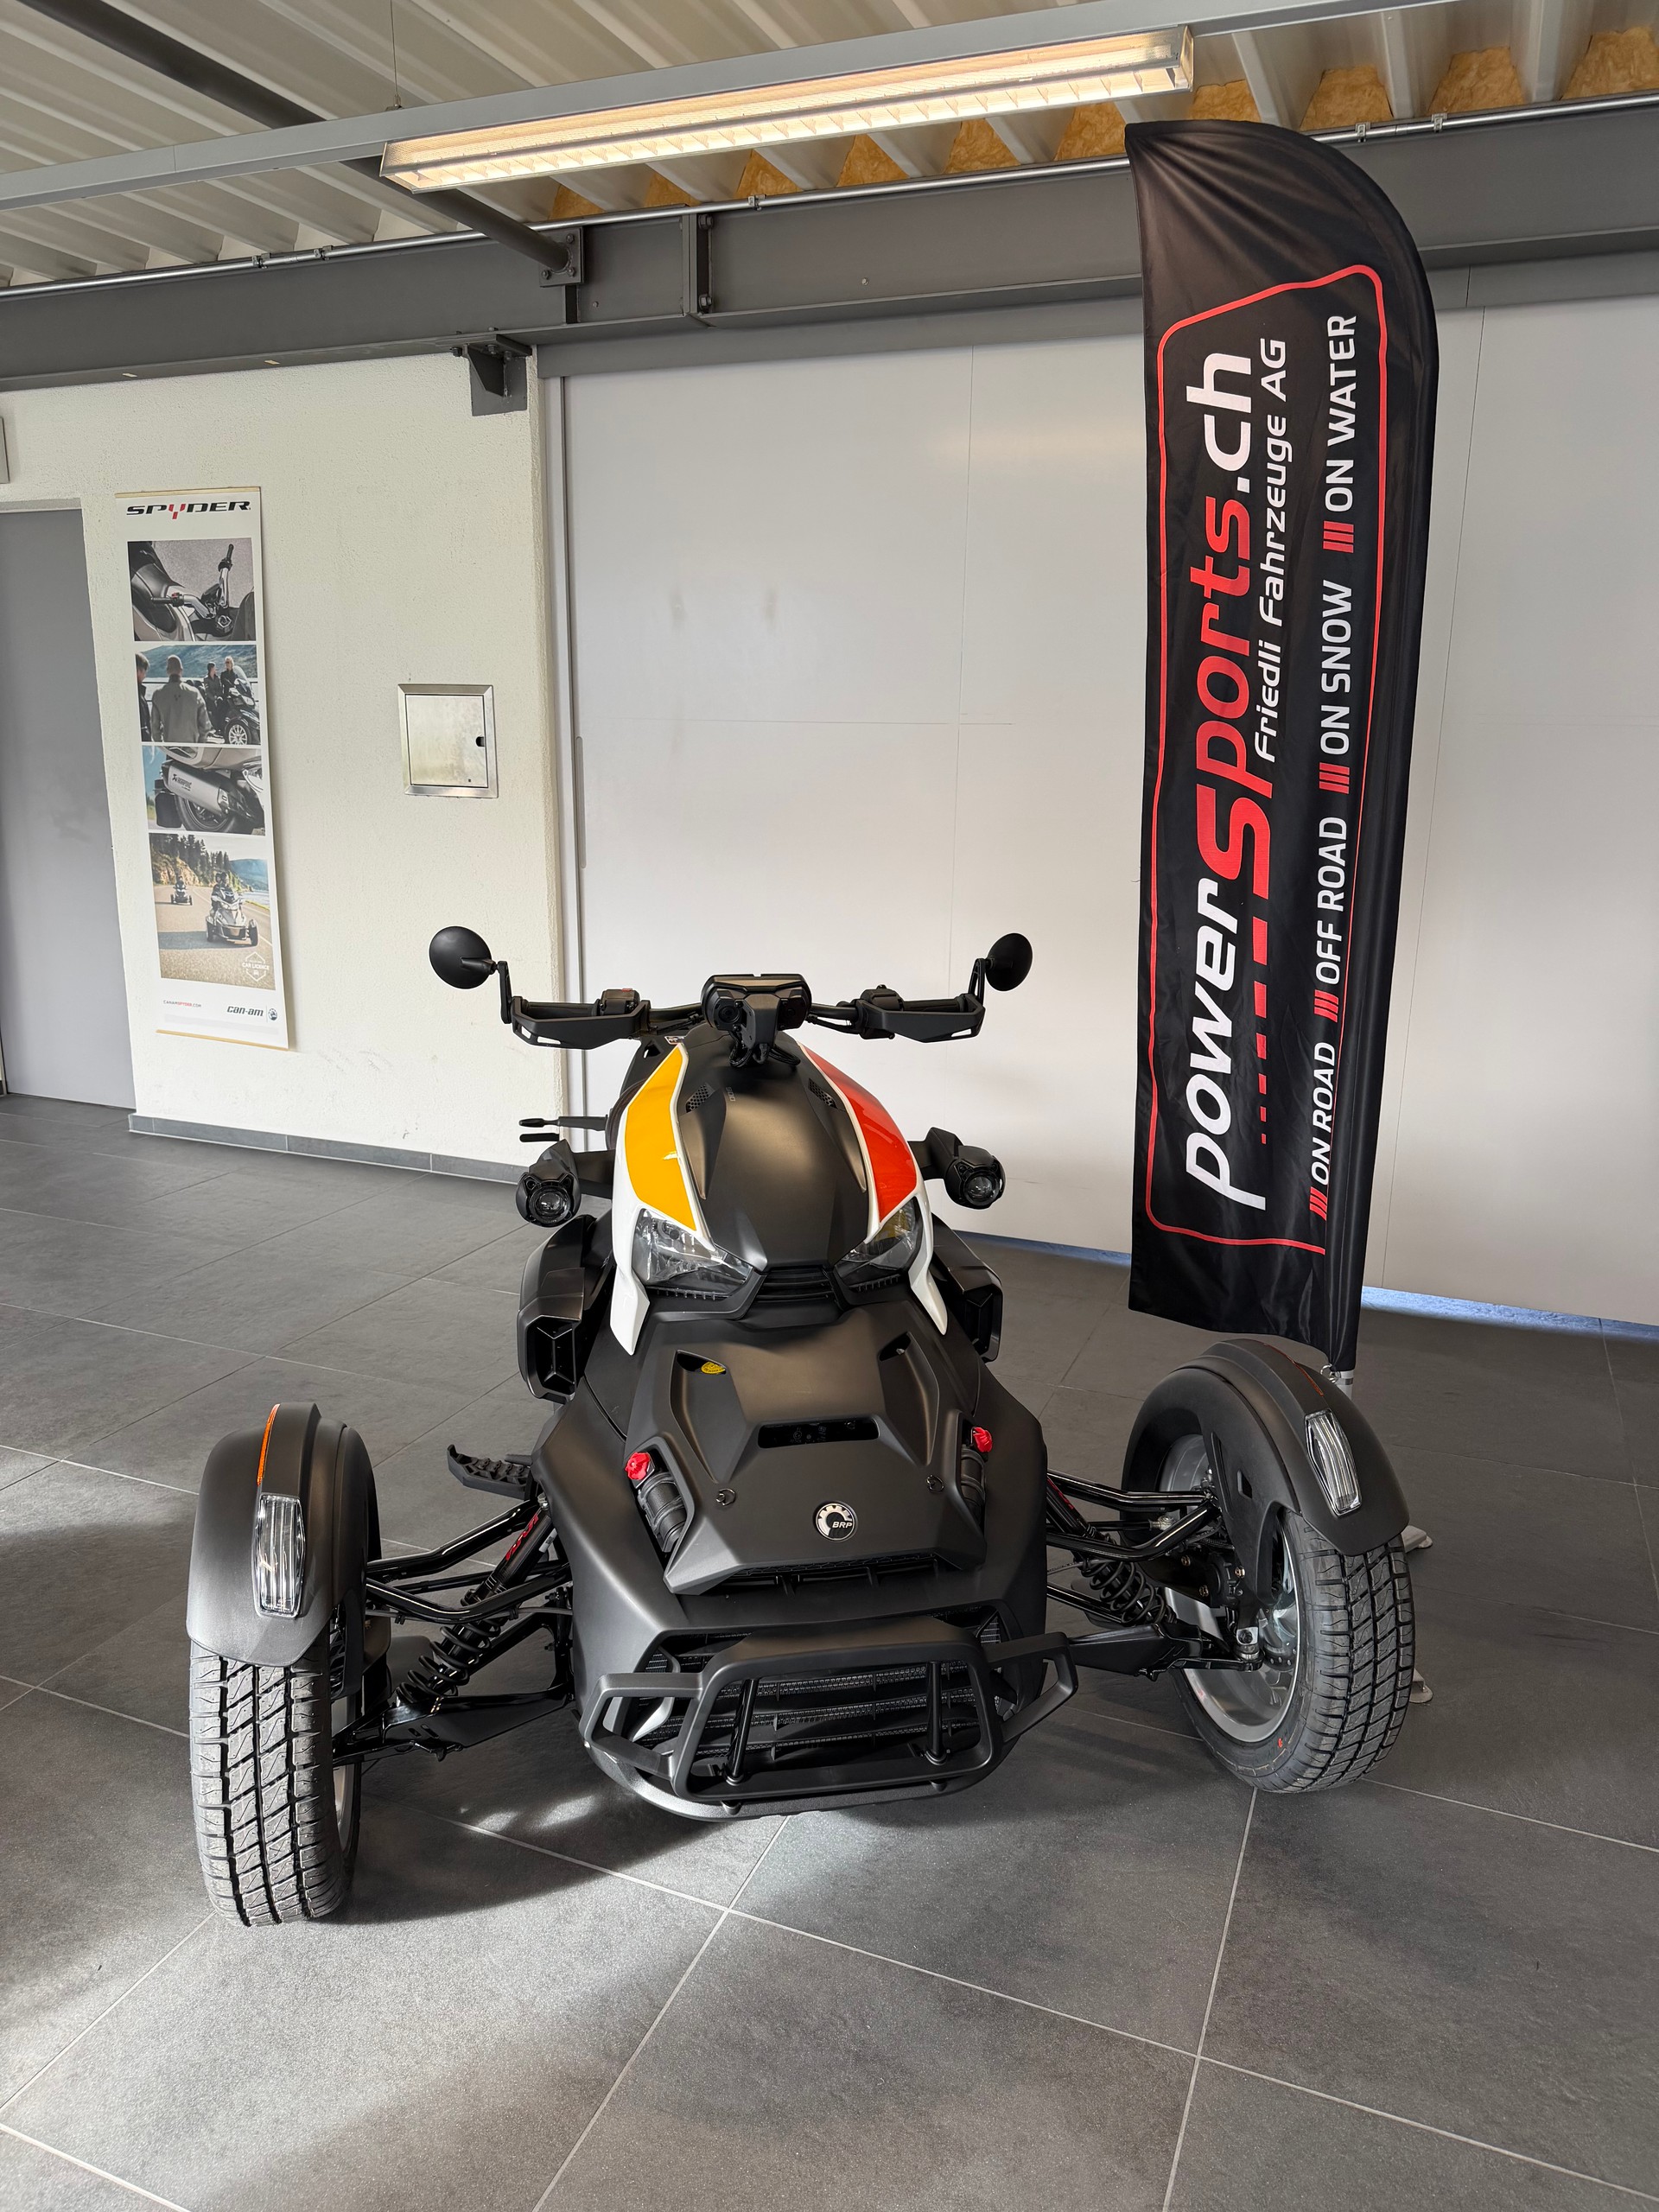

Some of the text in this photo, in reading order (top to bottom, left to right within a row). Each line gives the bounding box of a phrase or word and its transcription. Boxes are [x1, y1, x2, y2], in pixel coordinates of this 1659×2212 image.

[126, 501, 251, 519] SPYDER
[1255, 337, 1293, 763] Friedli Fahrzeuge AG
[1312, 315, 1357, 1185] ON ROAD OFF ROAD ON SNOW ON WATER
[226, 1005, 264, 1017] can-am
